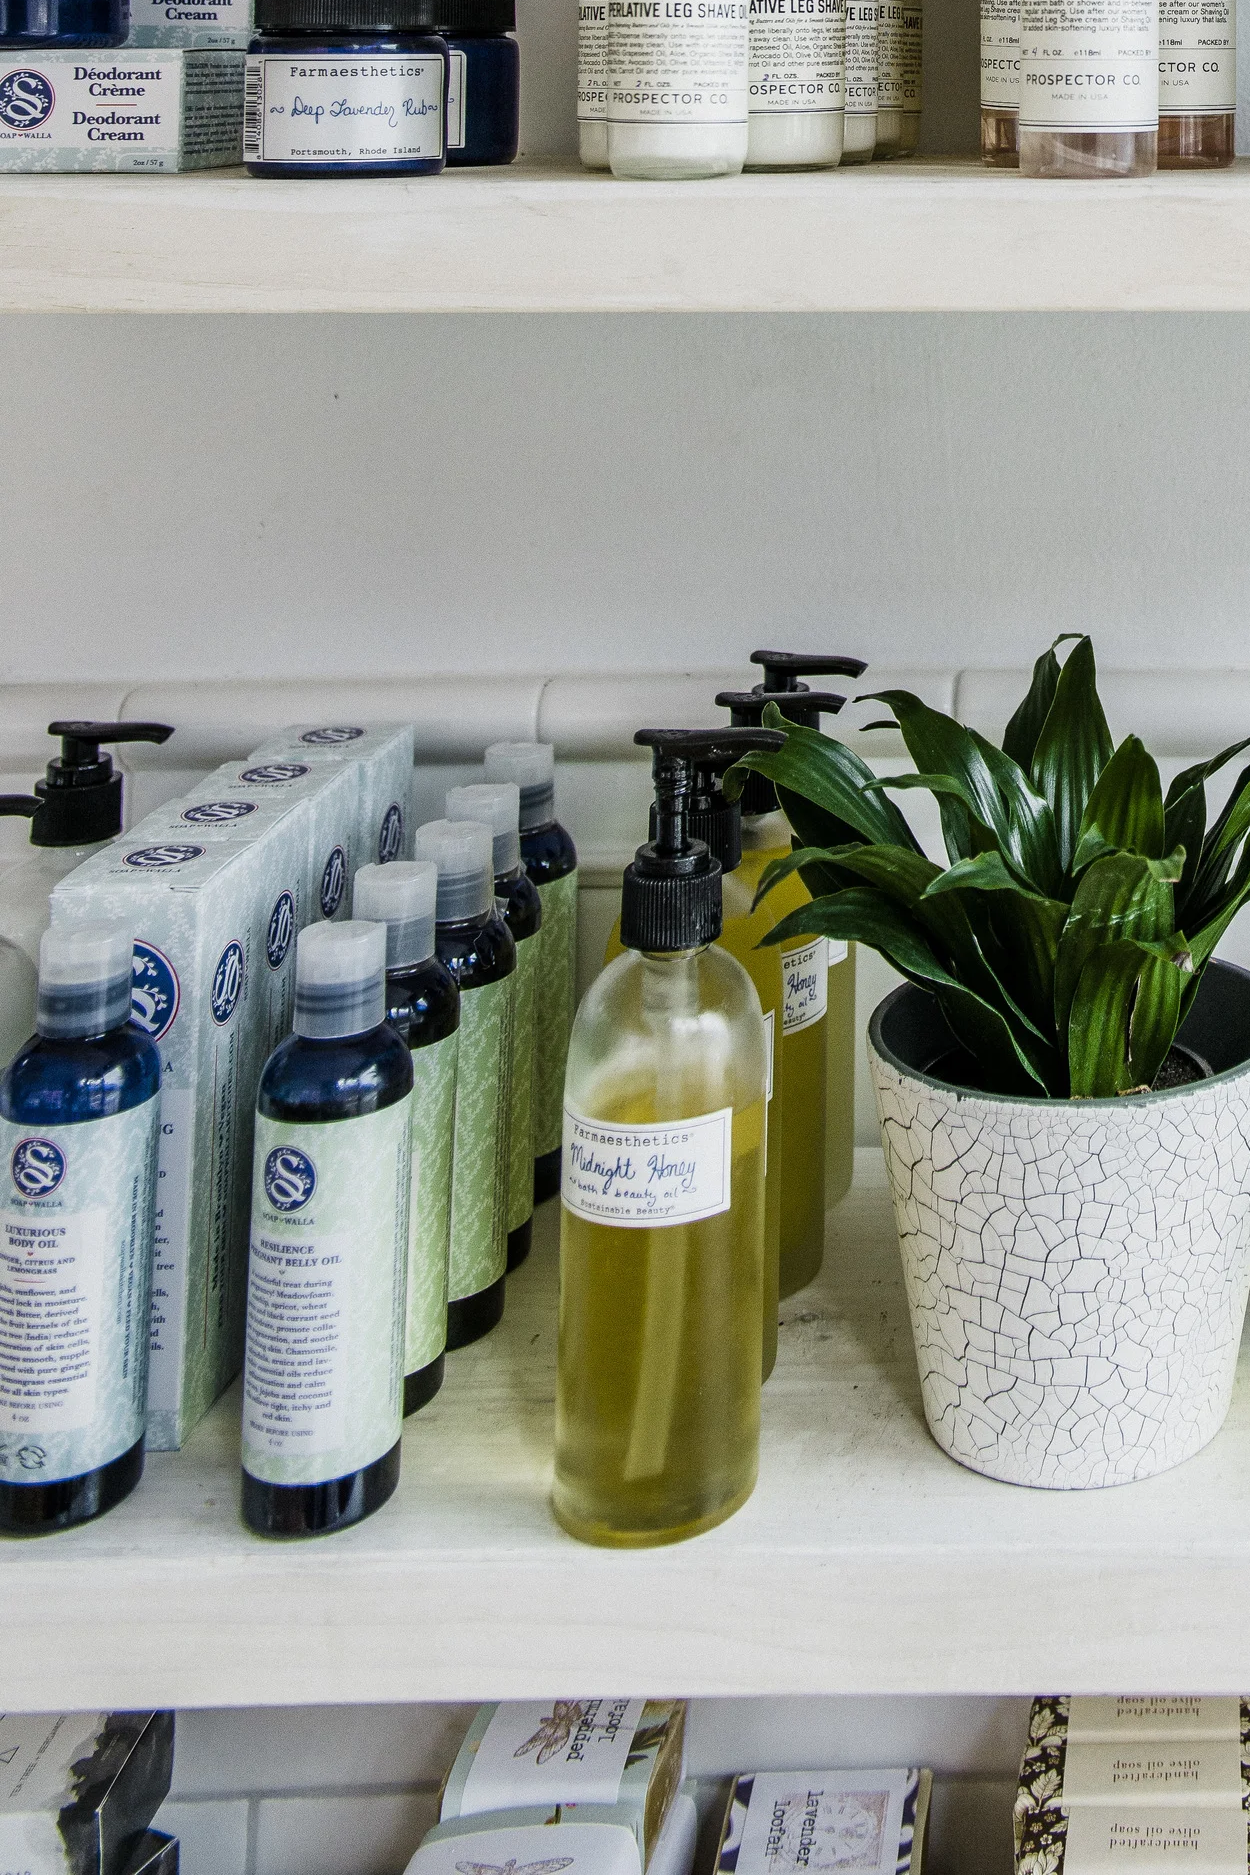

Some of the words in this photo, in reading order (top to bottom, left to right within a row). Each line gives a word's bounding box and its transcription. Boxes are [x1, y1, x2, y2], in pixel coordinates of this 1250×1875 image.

[165, 7, 218, 20] Cream
[666, 3, 692, 18] LEG
[698, 3, 736, 19] SHAVE
[73, 67, 162, 80] Déodorant
[1027, 74, 1115, 86] PROSPECTOR
[88, 83, 145, 96] Crème
[613, 93, 702, 104] PROSPECTOR
[72, 111, 161, 124] Deodorant
[291, 96, 325, 124] Deep
[330, 99, 398, 127] Lavender
[402, 98, 427, 116] Rub
[87, 128, 145, 141] Cream
[359, 147, 387, 155] Rhode
[393, 146, 421, 154] Island
[571, 1142, 636, 1190] Midnight
[647, 1153, 696, 1188] Honey
[577, 1180, 597, 1195] bath
[614, 1189, 656, 1207] beauty
[664, 1187, 678, 1198] oil
[8, 1237, 34, 1249] BODY
[38, 1239, 59, 1248] OIL
[260, 1239, 314, 1255] RESILIENCE
[285, 1256, 318, 1268] BELLY
[321, 1255, 343, 1266] OIL
[765, 1800, 791, 1858] loofah
[796, 1790, 824, 1866] lavender
[1110, 1823, 1140, 1833] soap
[1146, 1827, 1163, 1837] oil
[1169, 1828, 1200, 1838] olive
[1110, 1838, 1199, 1850] handcrafted
